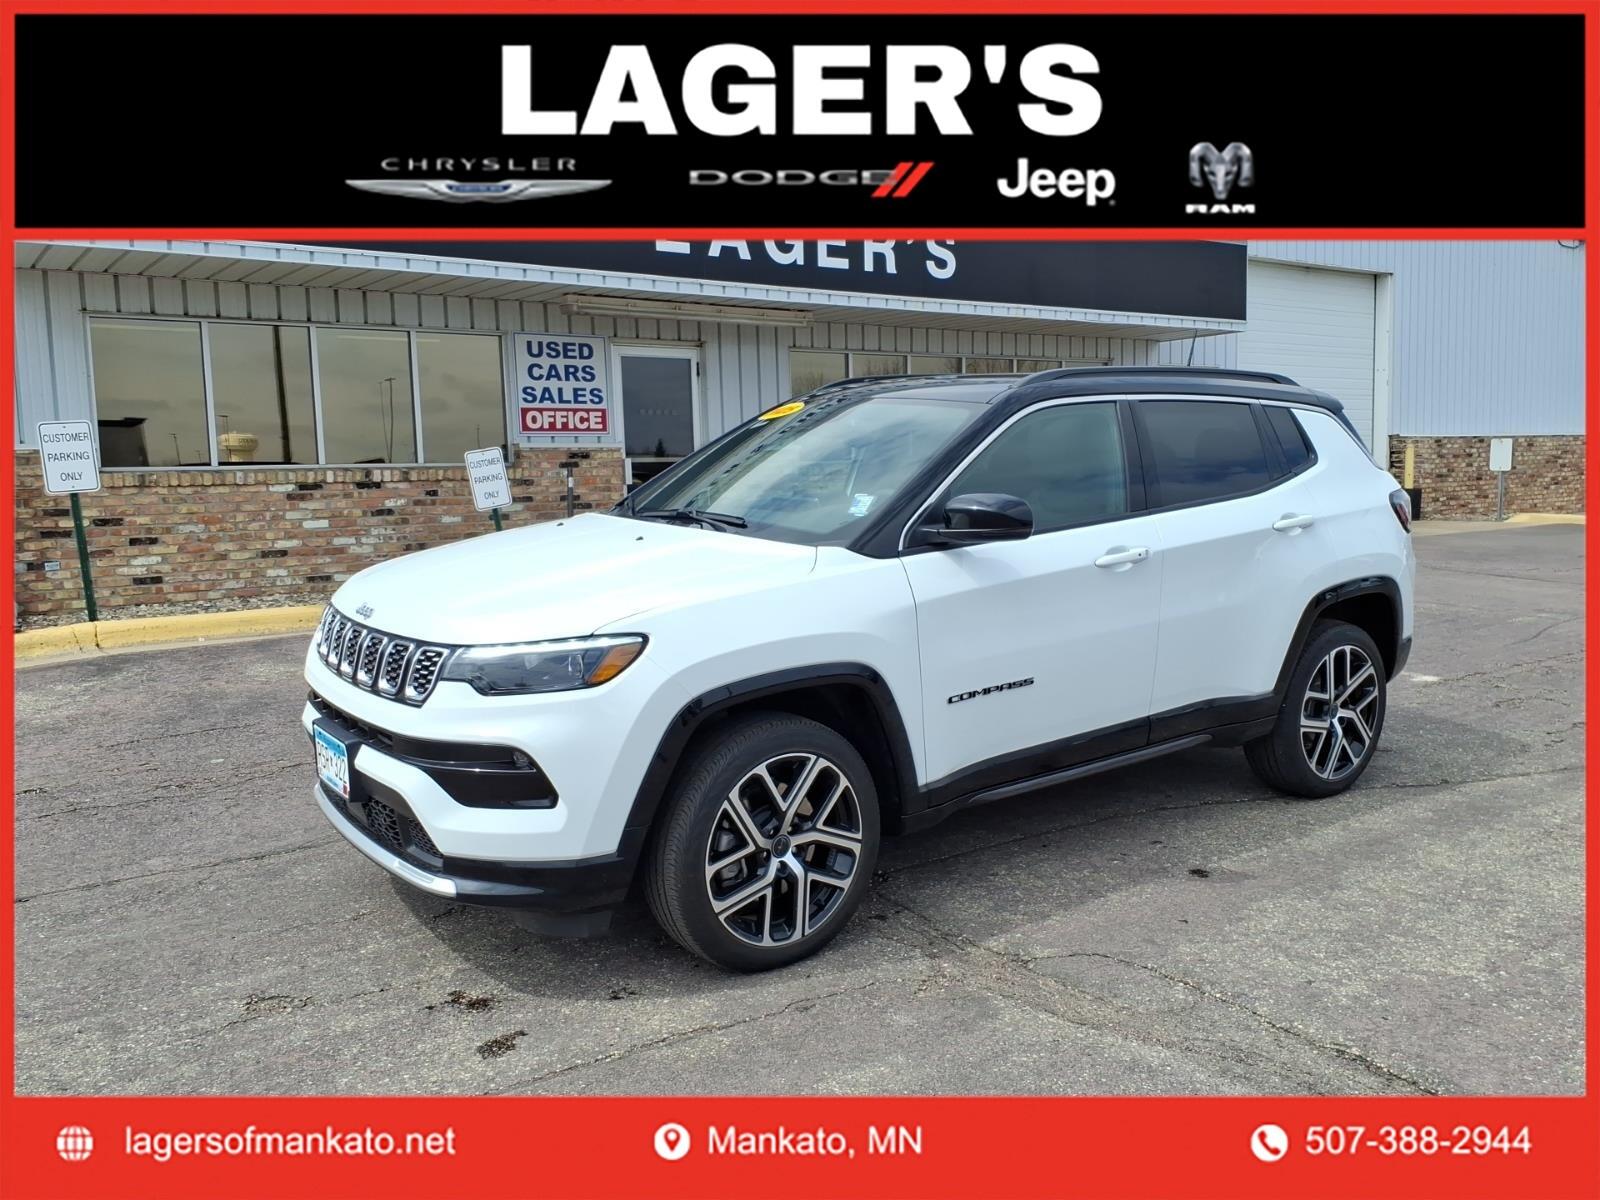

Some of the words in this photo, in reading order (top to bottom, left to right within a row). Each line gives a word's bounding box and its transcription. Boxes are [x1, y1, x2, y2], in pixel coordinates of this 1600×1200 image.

[655, 238, 957, 280] GERS
[526, 340, 594, 360] USED
[527, 363, 596, 383] CARS
[521, 386, 604, 405] SALES
[525, 410, 603, 430] OFFICE
[42, 432, 89, 443] CUSTOMER
[47, 451, 90, 462] PARKING
[470, 456, 502, 469] CUSTOMER
[60, 471, 83, 482] ONLY
[474, 472, 503, 484] PARKING
[484, 490, 499, 500] ONLY
[947, 677, 1035, 705] COMPASS
